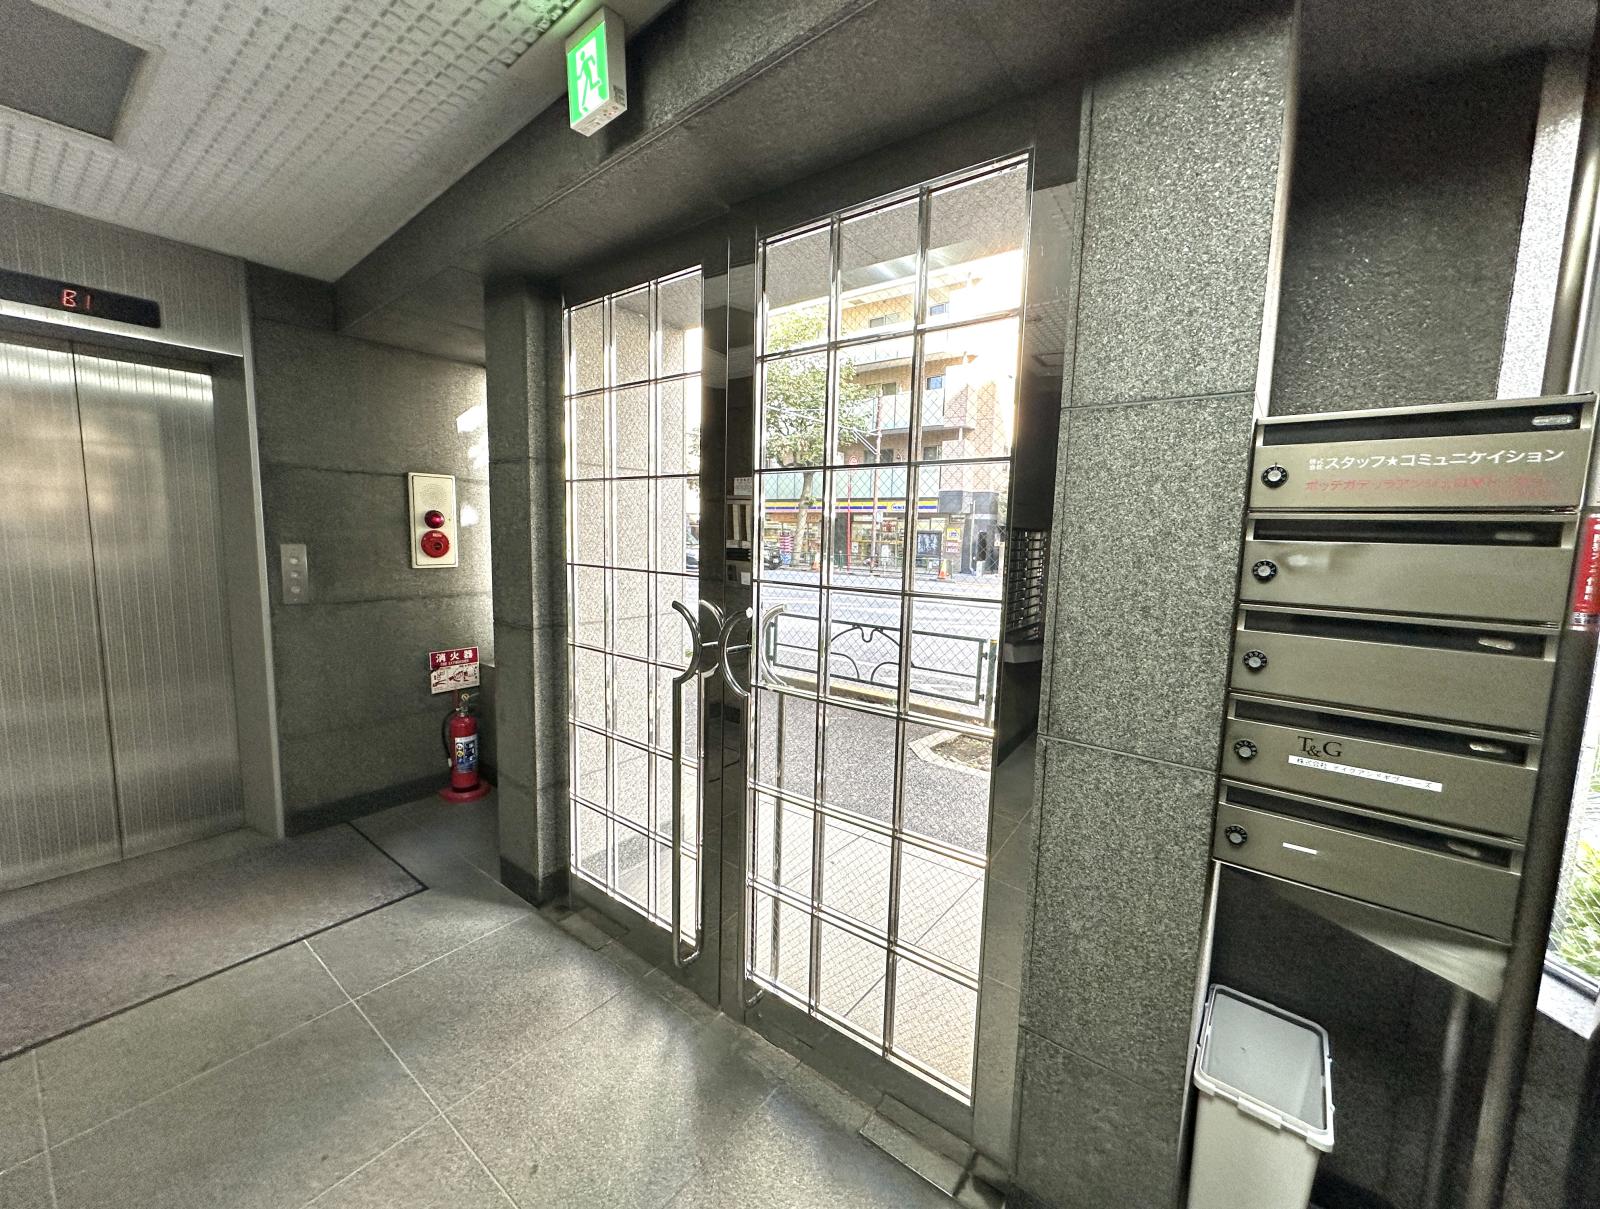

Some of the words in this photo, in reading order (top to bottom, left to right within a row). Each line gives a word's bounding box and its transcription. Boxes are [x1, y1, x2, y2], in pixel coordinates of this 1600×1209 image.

[62, 289, 91, 310] B1
[436, 650, 473, 663] 消火器
[1297, 736, 1343, 757] T&G
